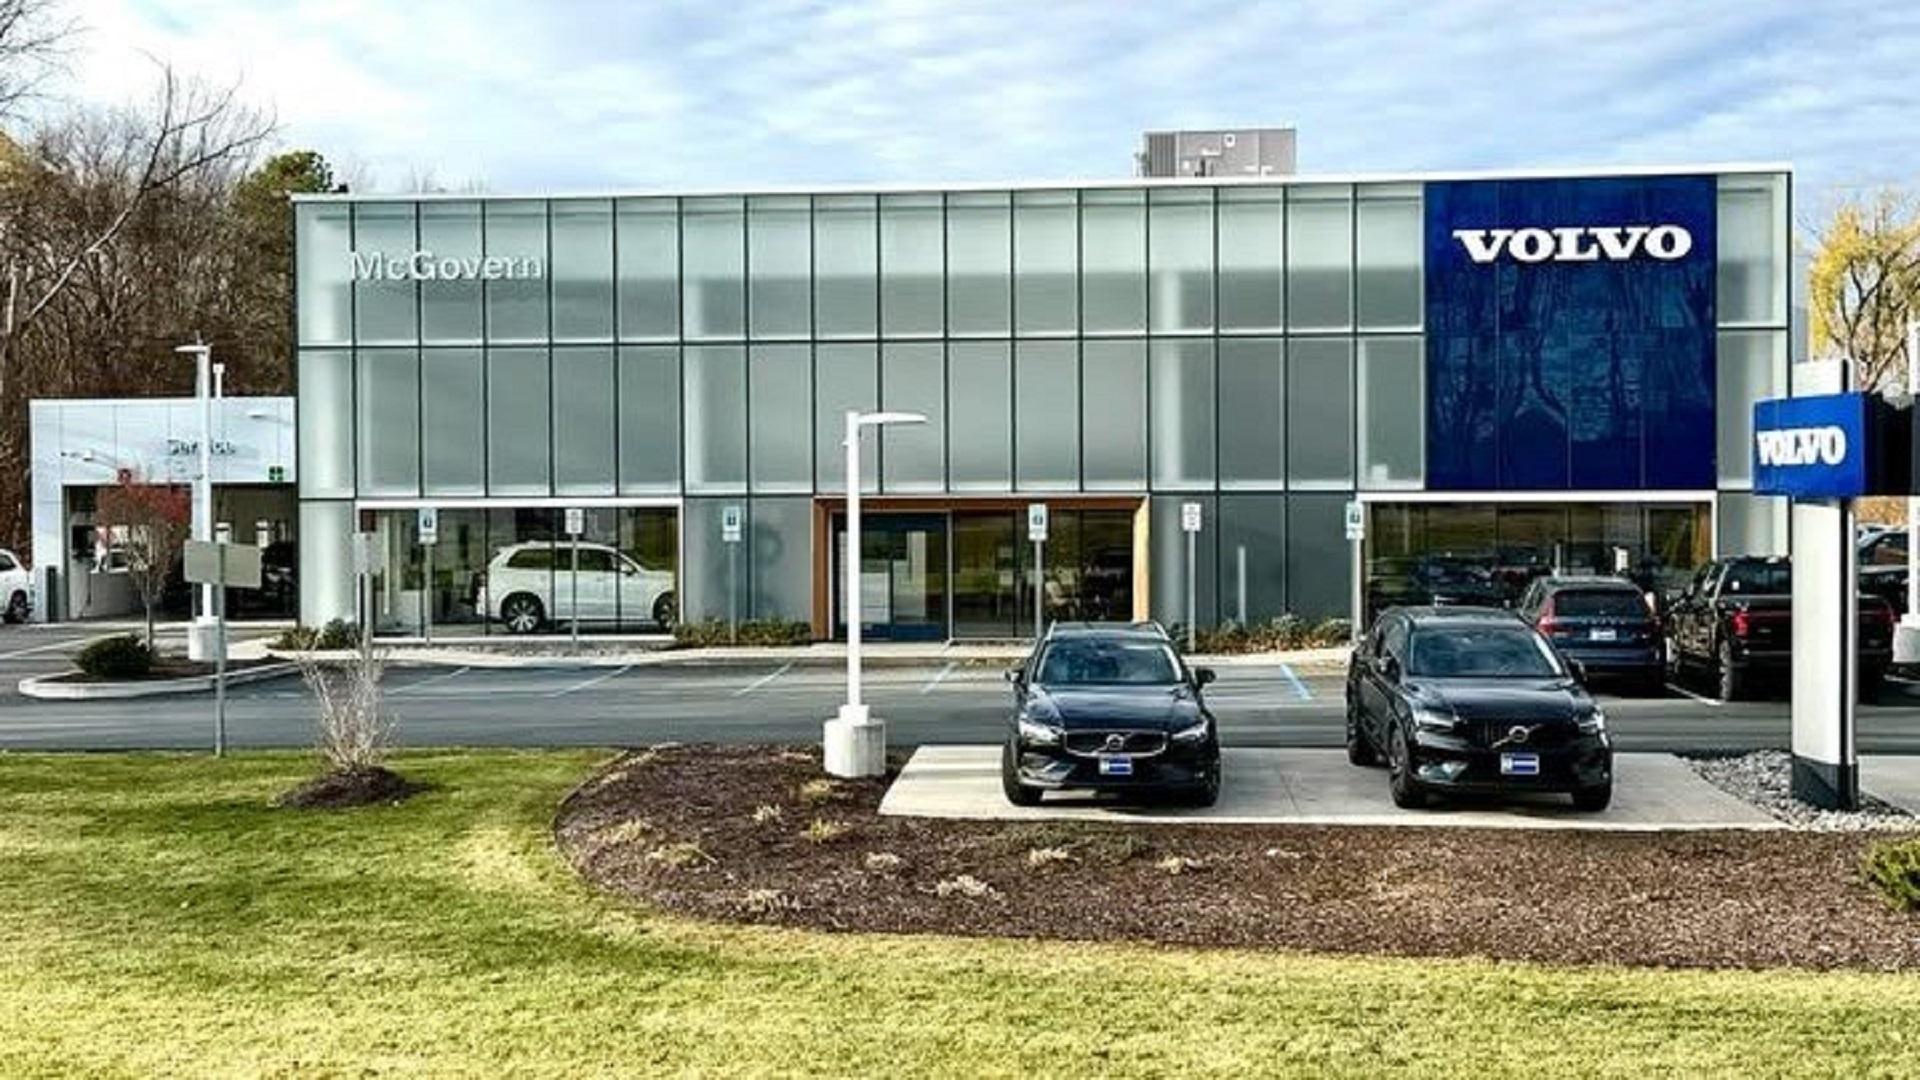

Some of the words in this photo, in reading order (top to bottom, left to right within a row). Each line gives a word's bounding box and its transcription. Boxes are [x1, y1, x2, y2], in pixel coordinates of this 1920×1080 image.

[1452, 225, 1692, 263] VOLVO
[350, 251, 543, 281] McGovern
[167, 438, 236, 457] Serice
[1756, 425, 1846, 466] VOLVO
